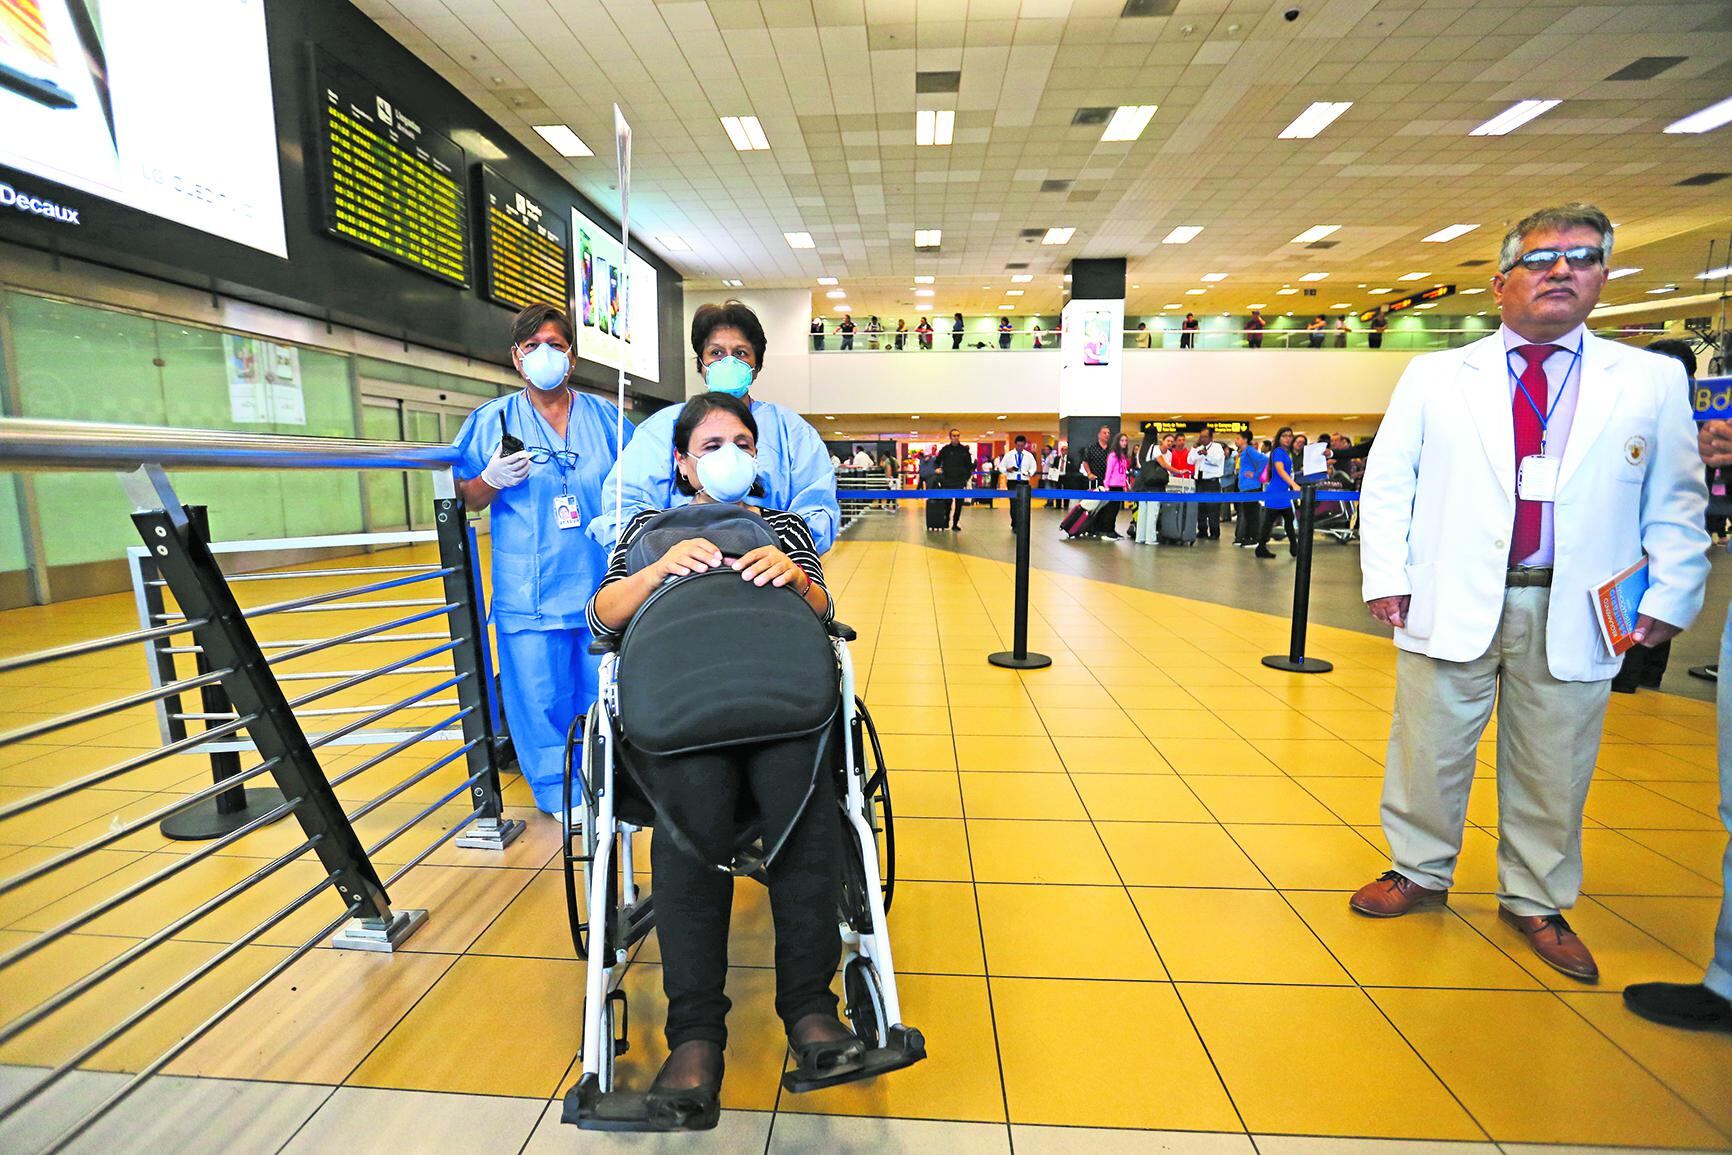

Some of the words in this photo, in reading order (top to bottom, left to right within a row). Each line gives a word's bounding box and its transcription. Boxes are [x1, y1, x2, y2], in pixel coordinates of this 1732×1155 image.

[0, 182, 81, 225] Decaux
[1604, 598, 1618, 637] REGLAMENTO
[1610, 588, 1627, 636] SANITARIO
